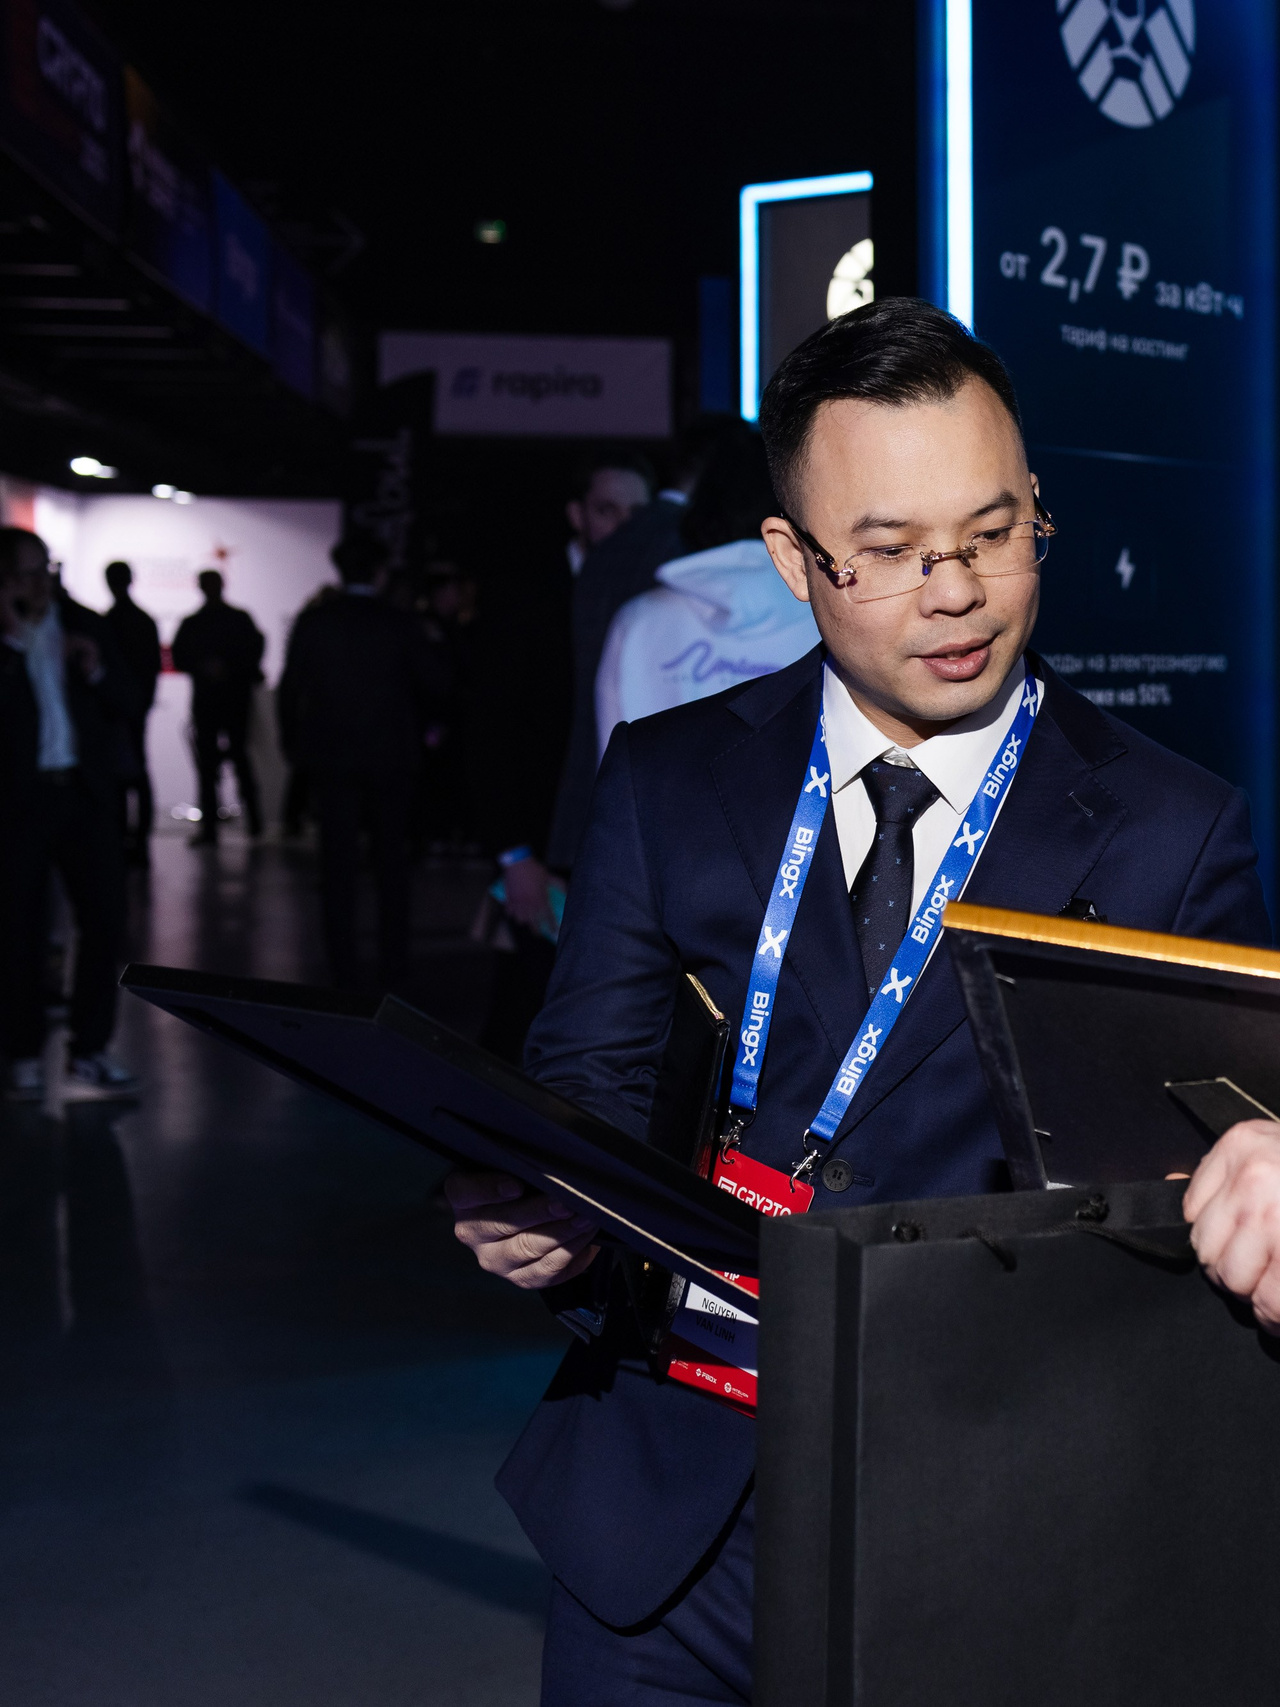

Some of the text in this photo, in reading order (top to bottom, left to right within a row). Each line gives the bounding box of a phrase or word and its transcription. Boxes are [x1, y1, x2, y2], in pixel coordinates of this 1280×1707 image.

[1000, 250, 1030, 281] от
[1040, 225, 1107, 304] 2,7
[982, 733, 1021, 800] Bingx
[779, 826, 813, 899] Bingx
[911, 874, 955, 944] Bingx
[741, 991, 770, 1067] Bingx
[836, 1023, 882, 1095] Bingx
[736, 1186, 791, 1217] CRYPTO
[724, 1271, 740, 1281] VIP
[696, 1314, 736, 1344] VAN LINH
[702, 1297, 737, 1324] NGUYEN
